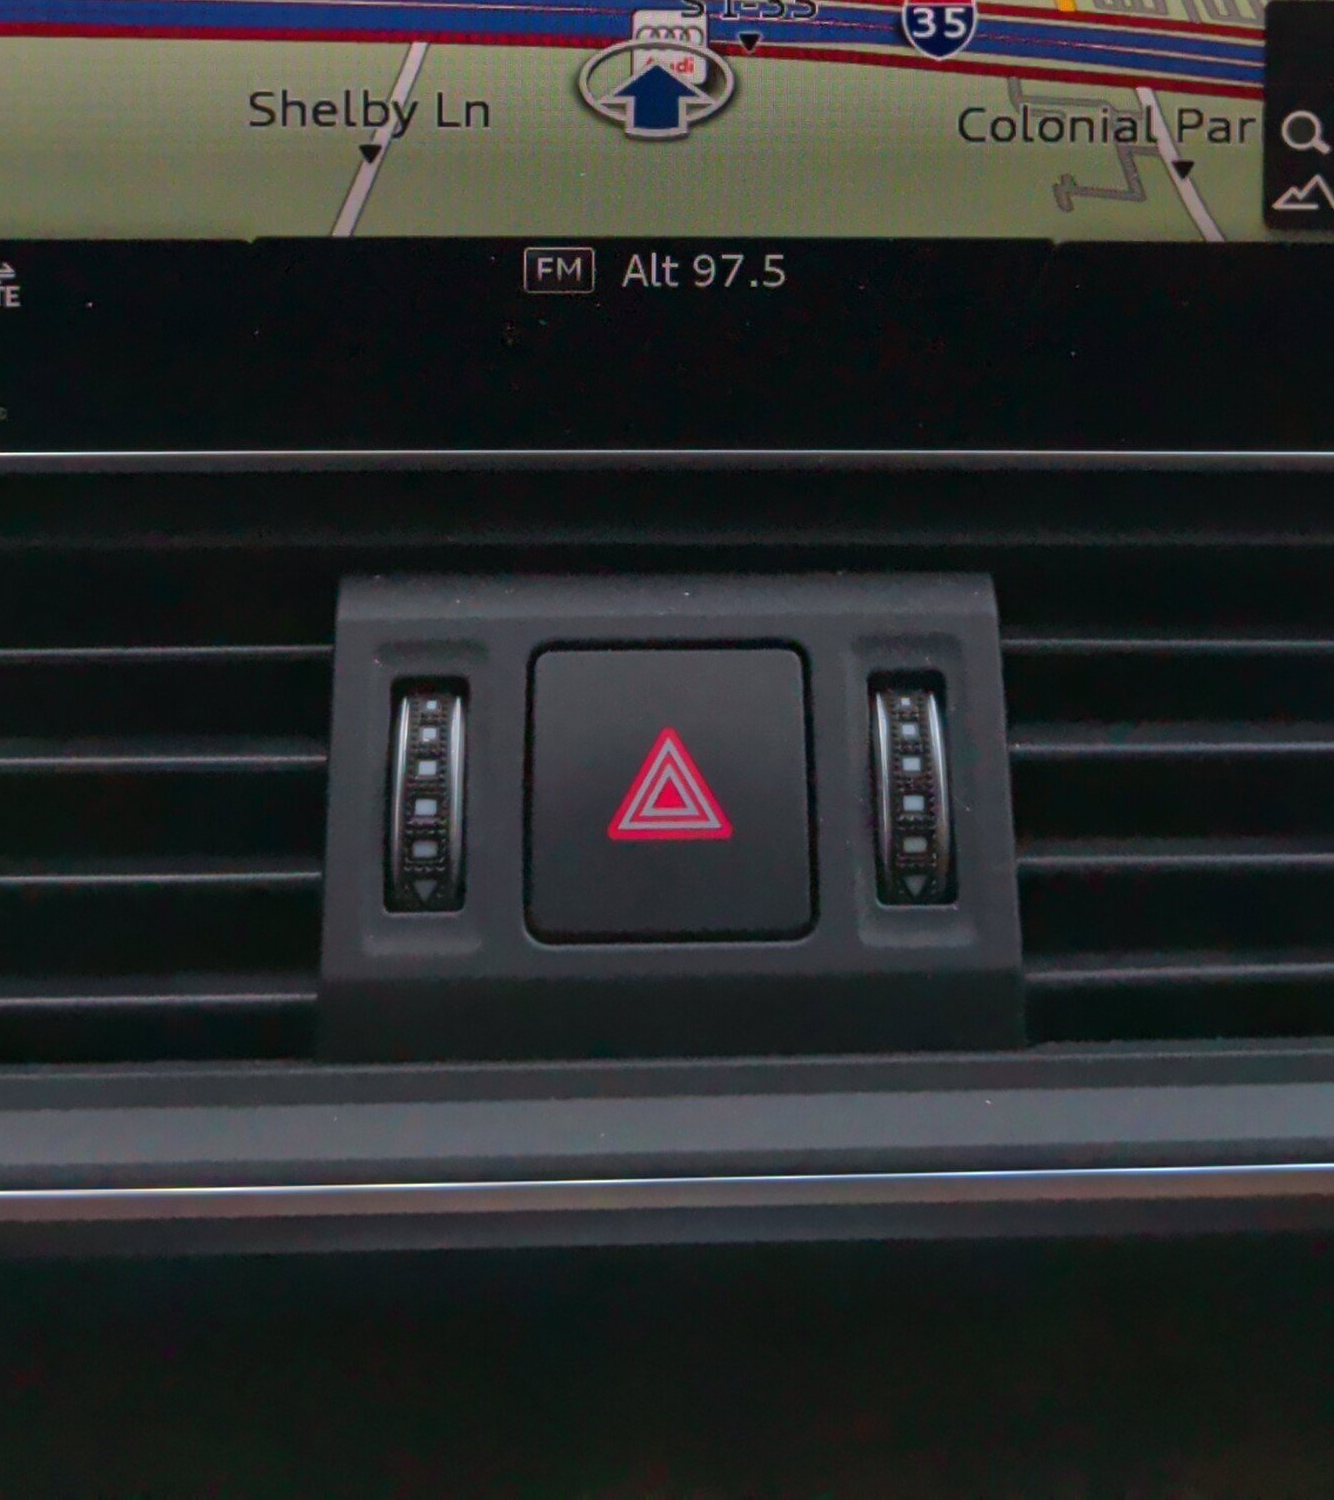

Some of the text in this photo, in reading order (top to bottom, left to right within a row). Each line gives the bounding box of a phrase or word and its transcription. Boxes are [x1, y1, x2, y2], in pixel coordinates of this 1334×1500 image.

[910, 7, 968, 41] 35
[248, 89, 490, 139] Shelby Ln
[957, 105, 1257, 145] Colonial Par
[536, 257, 581, 282] FM
[621, 252, 787, 288] Alt 97.5
